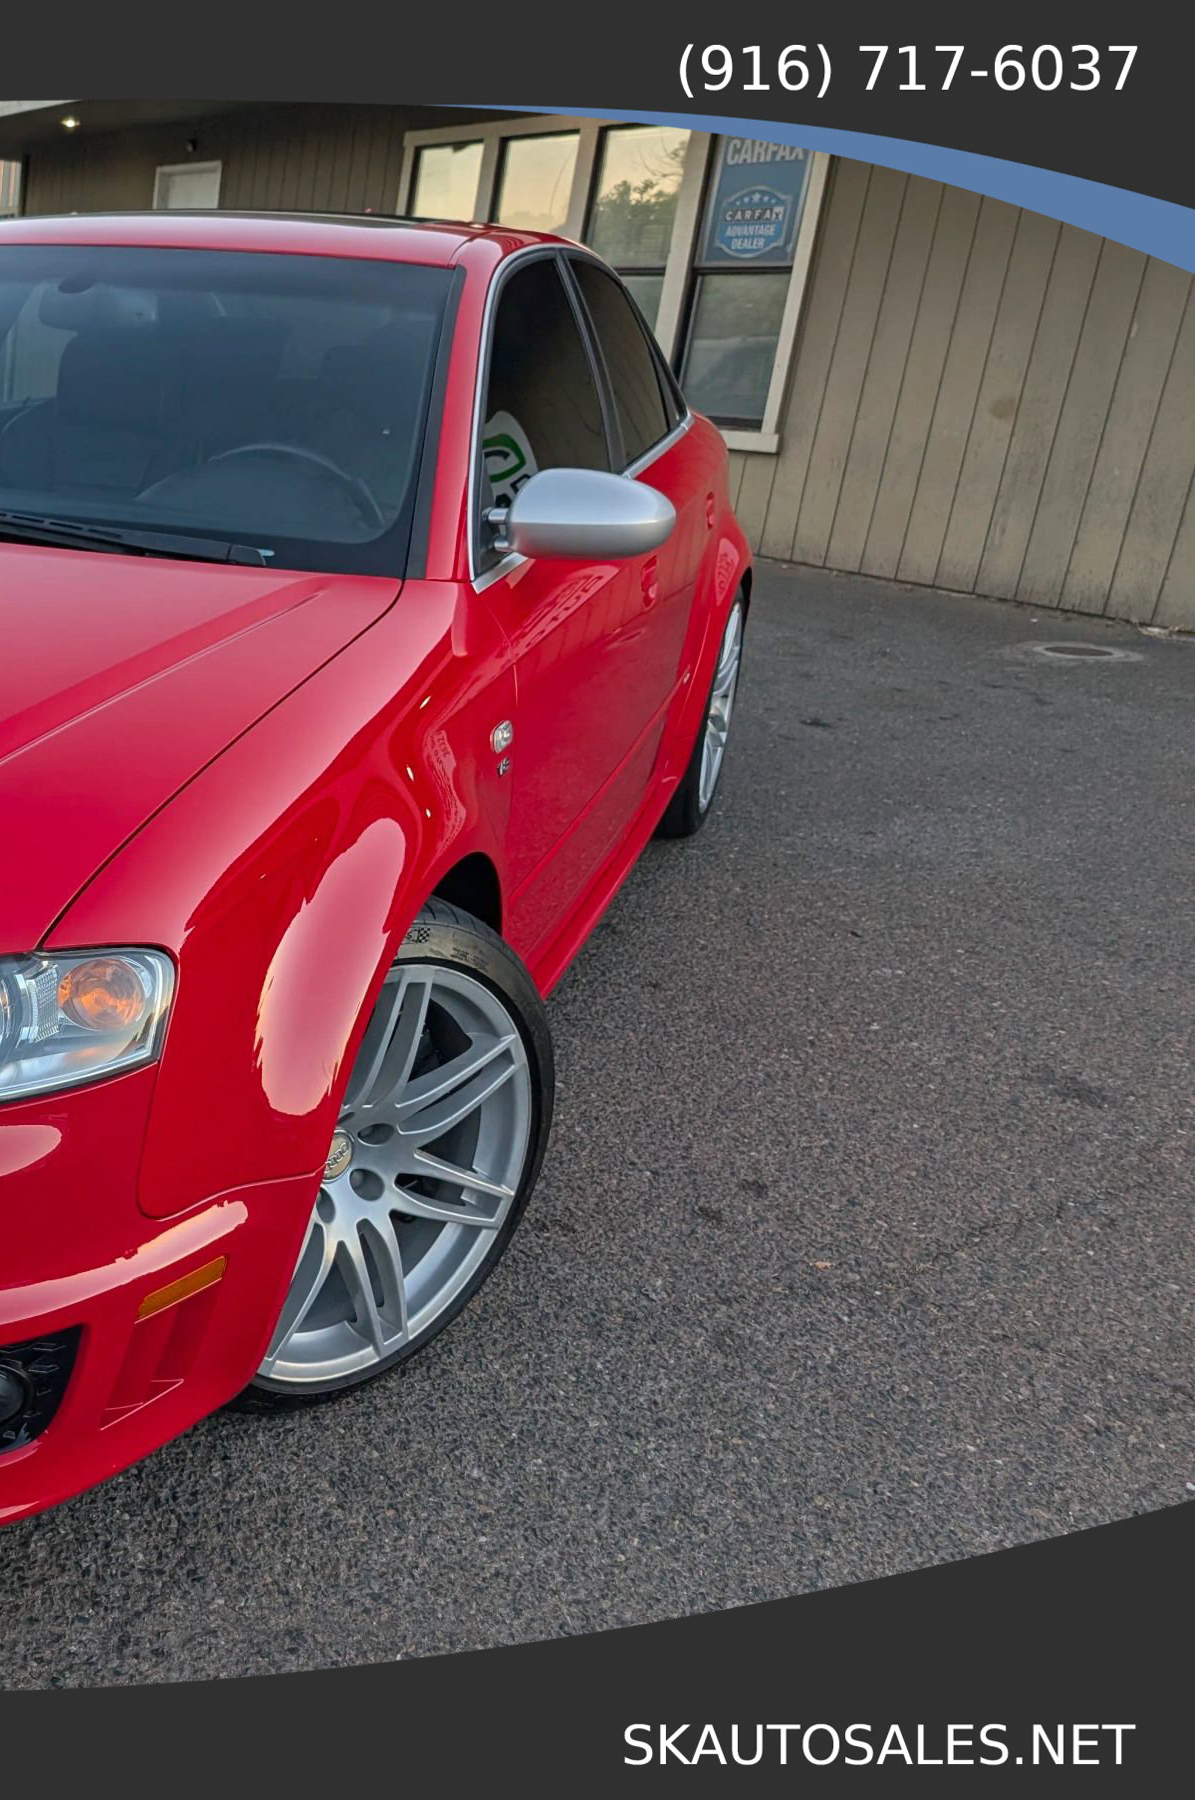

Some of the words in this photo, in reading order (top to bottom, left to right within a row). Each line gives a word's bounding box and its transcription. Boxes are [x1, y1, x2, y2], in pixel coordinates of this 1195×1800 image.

[725, 207, 784, 222] CARFAX
[724, 224, 776, 237] ADVANTAGE
[731, 238, 765, 250] DEALER
